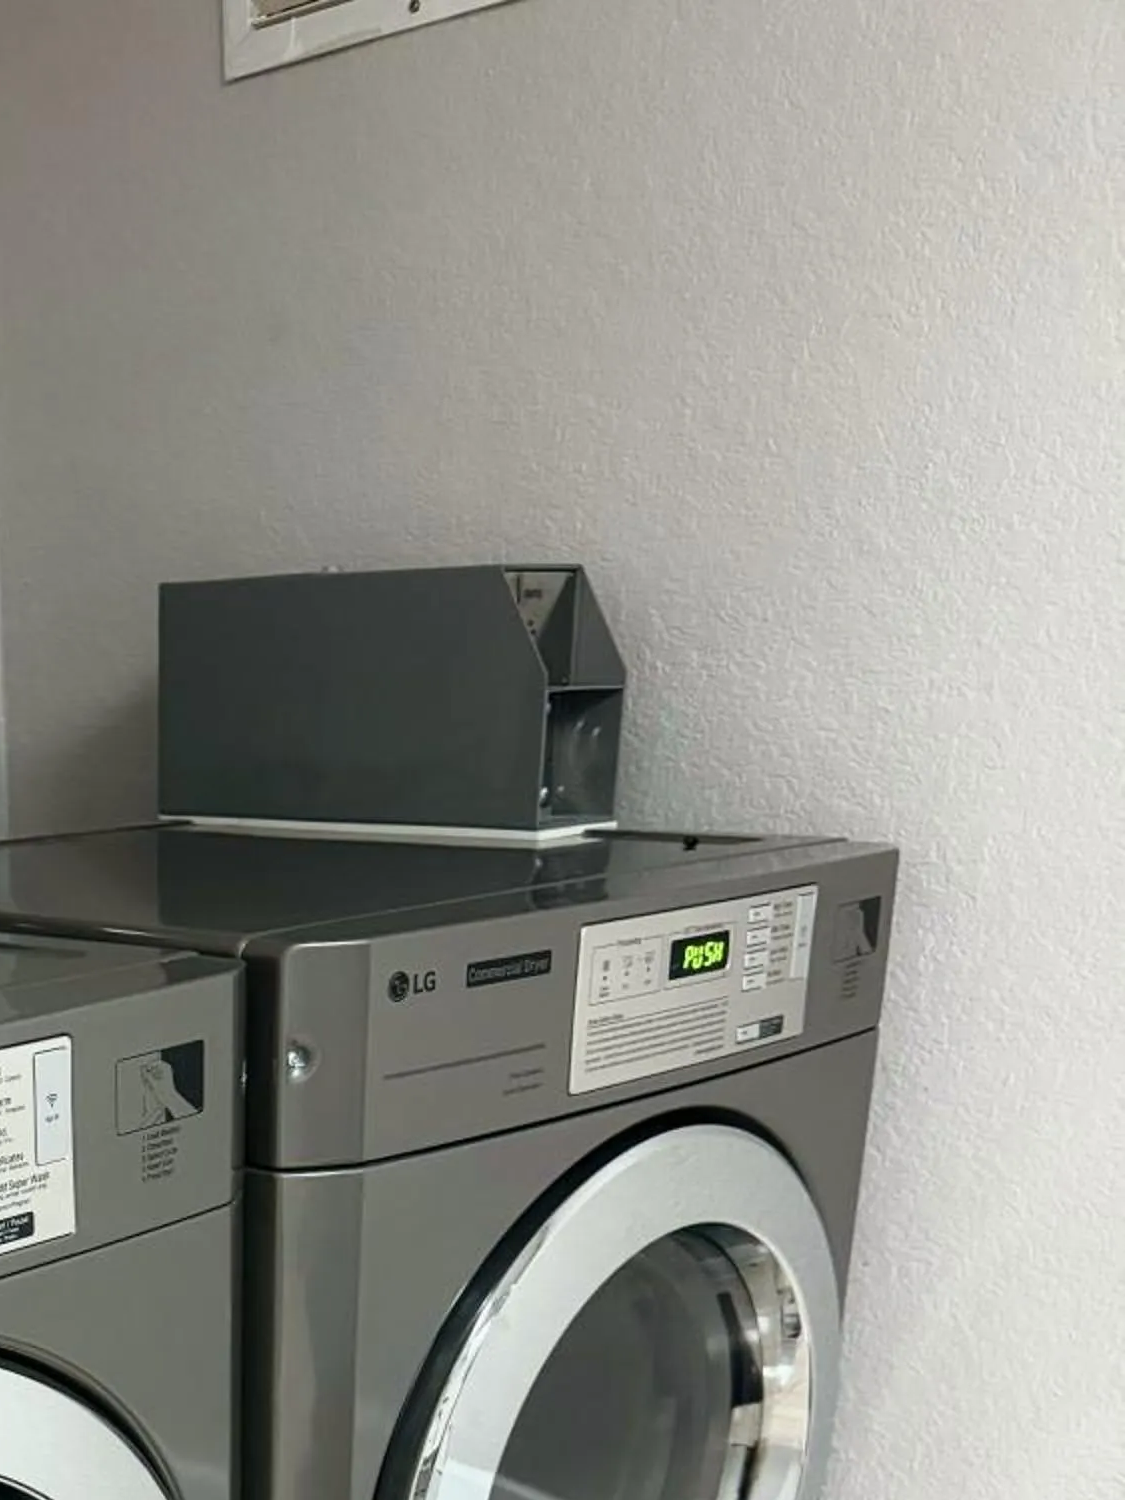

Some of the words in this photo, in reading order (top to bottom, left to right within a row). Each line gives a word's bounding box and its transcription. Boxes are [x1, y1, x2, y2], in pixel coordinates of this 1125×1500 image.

[682, 941, 725, 970] PUSH
[413, 971, 436, 994] LG
[469, 962, 520, 981] Commercial
